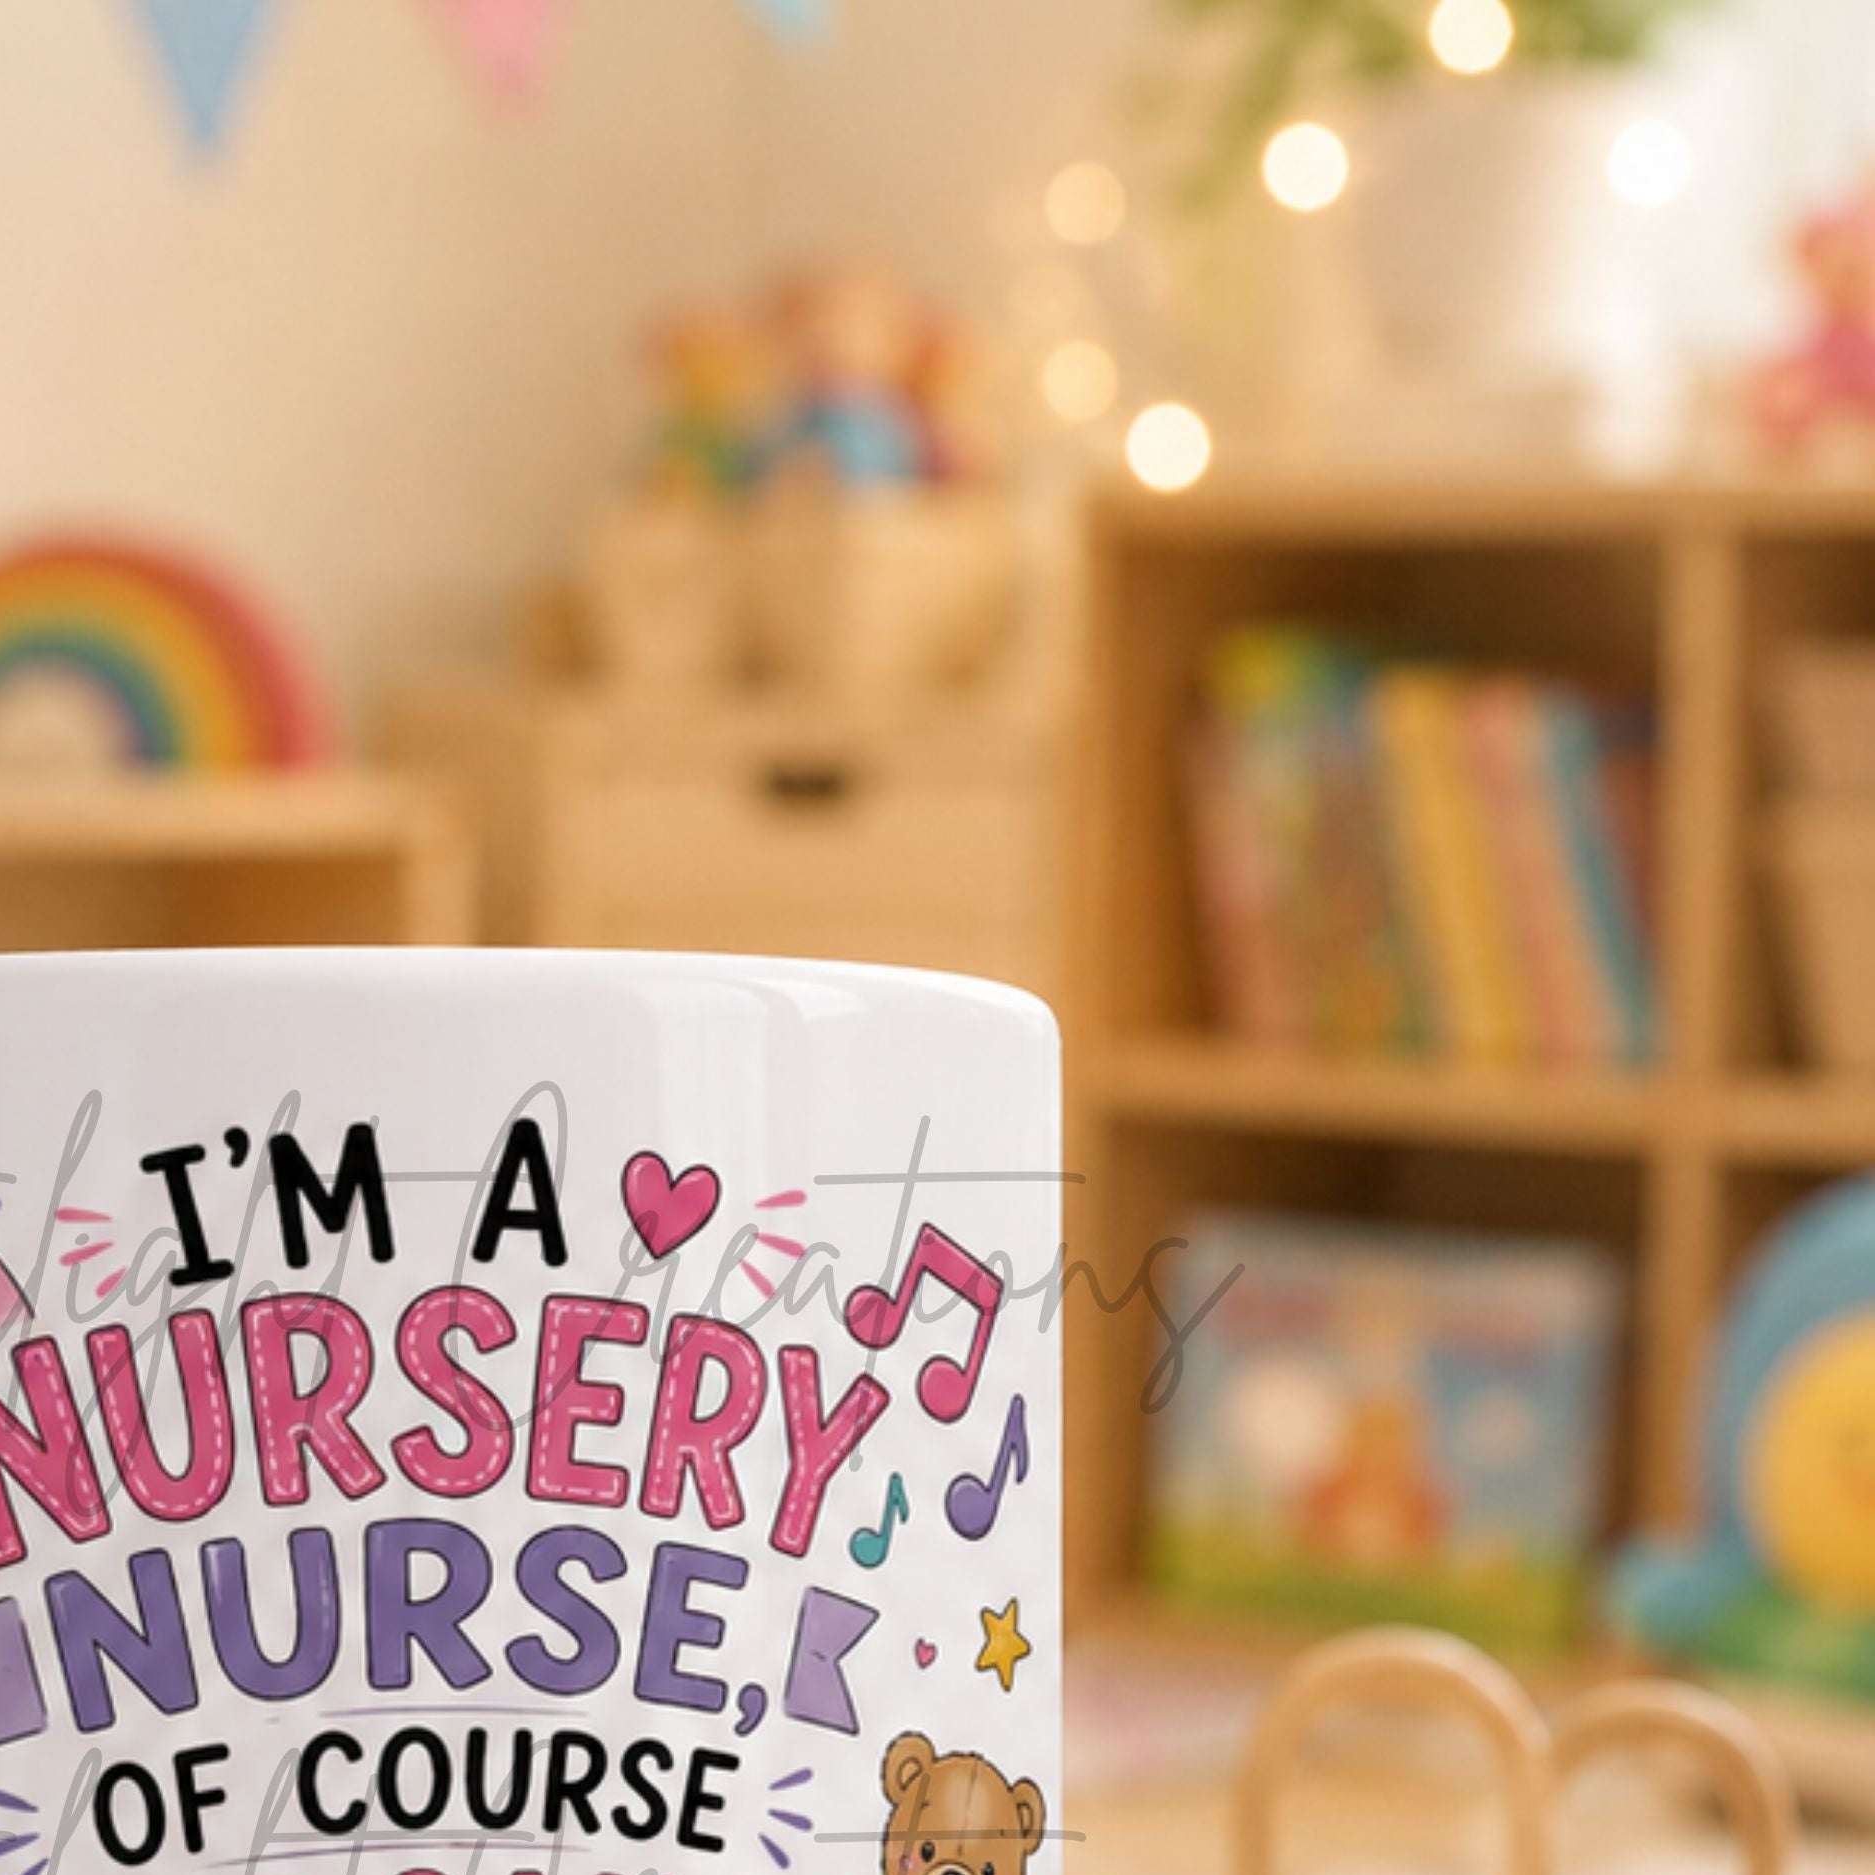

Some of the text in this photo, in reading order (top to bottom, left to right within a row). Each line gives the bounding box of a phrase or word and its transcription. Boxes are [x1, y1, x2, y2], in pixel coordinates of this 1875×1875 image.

[471, 1117, 569, 1268] A
[43, 1517, 769, 1736] NURSE,
[92, 1726, 740, 1866] OF COURSE
